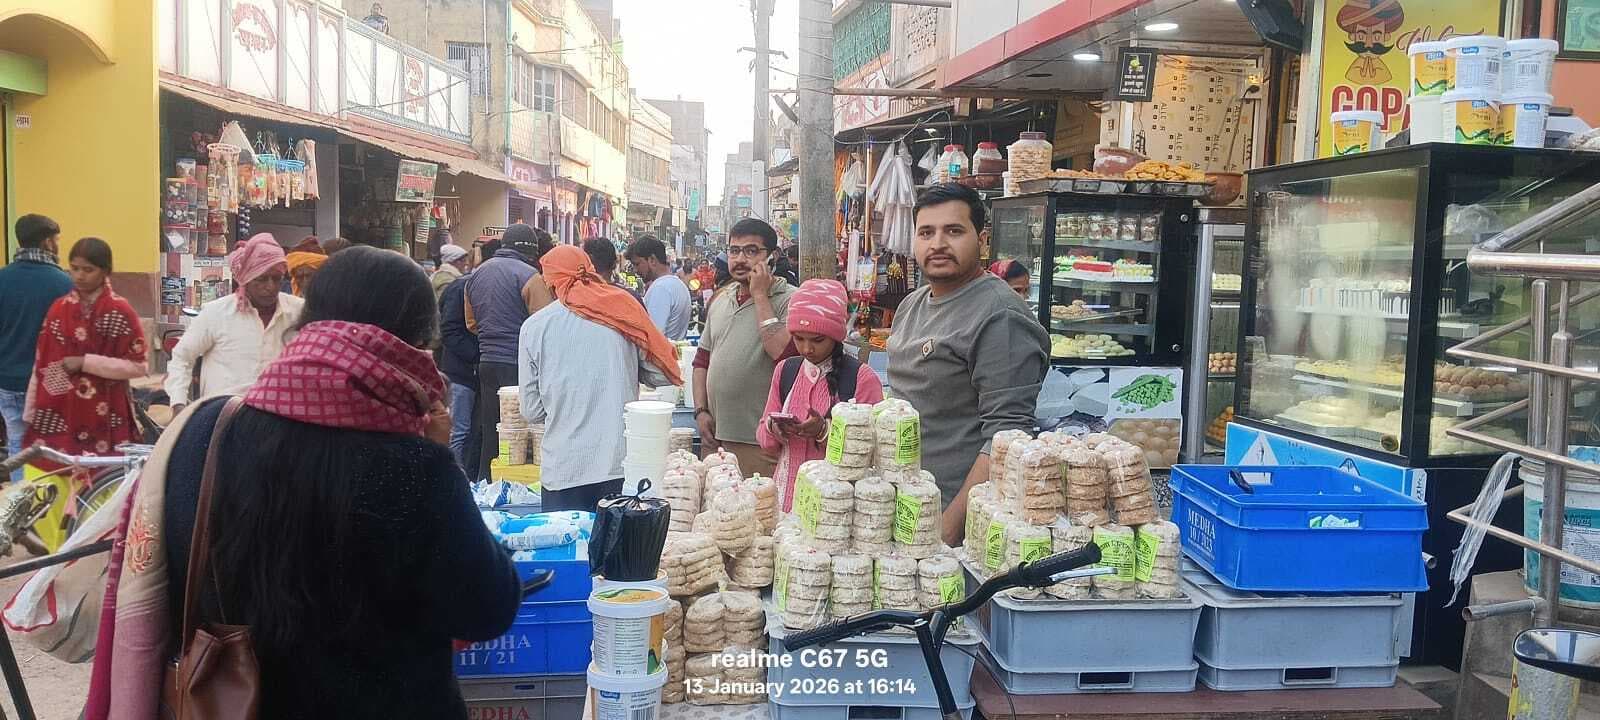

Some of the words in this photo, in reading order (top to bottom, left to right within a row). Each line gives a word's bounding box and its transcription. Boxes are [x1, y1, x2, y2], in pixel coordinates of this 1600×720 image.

[1331, 85, 1410, 131] GOP
[1187, 508, 1215, 539] MEDHA
[463, 633, 531, 650] EDHA
[468, 704, 530, 720] EDHA
